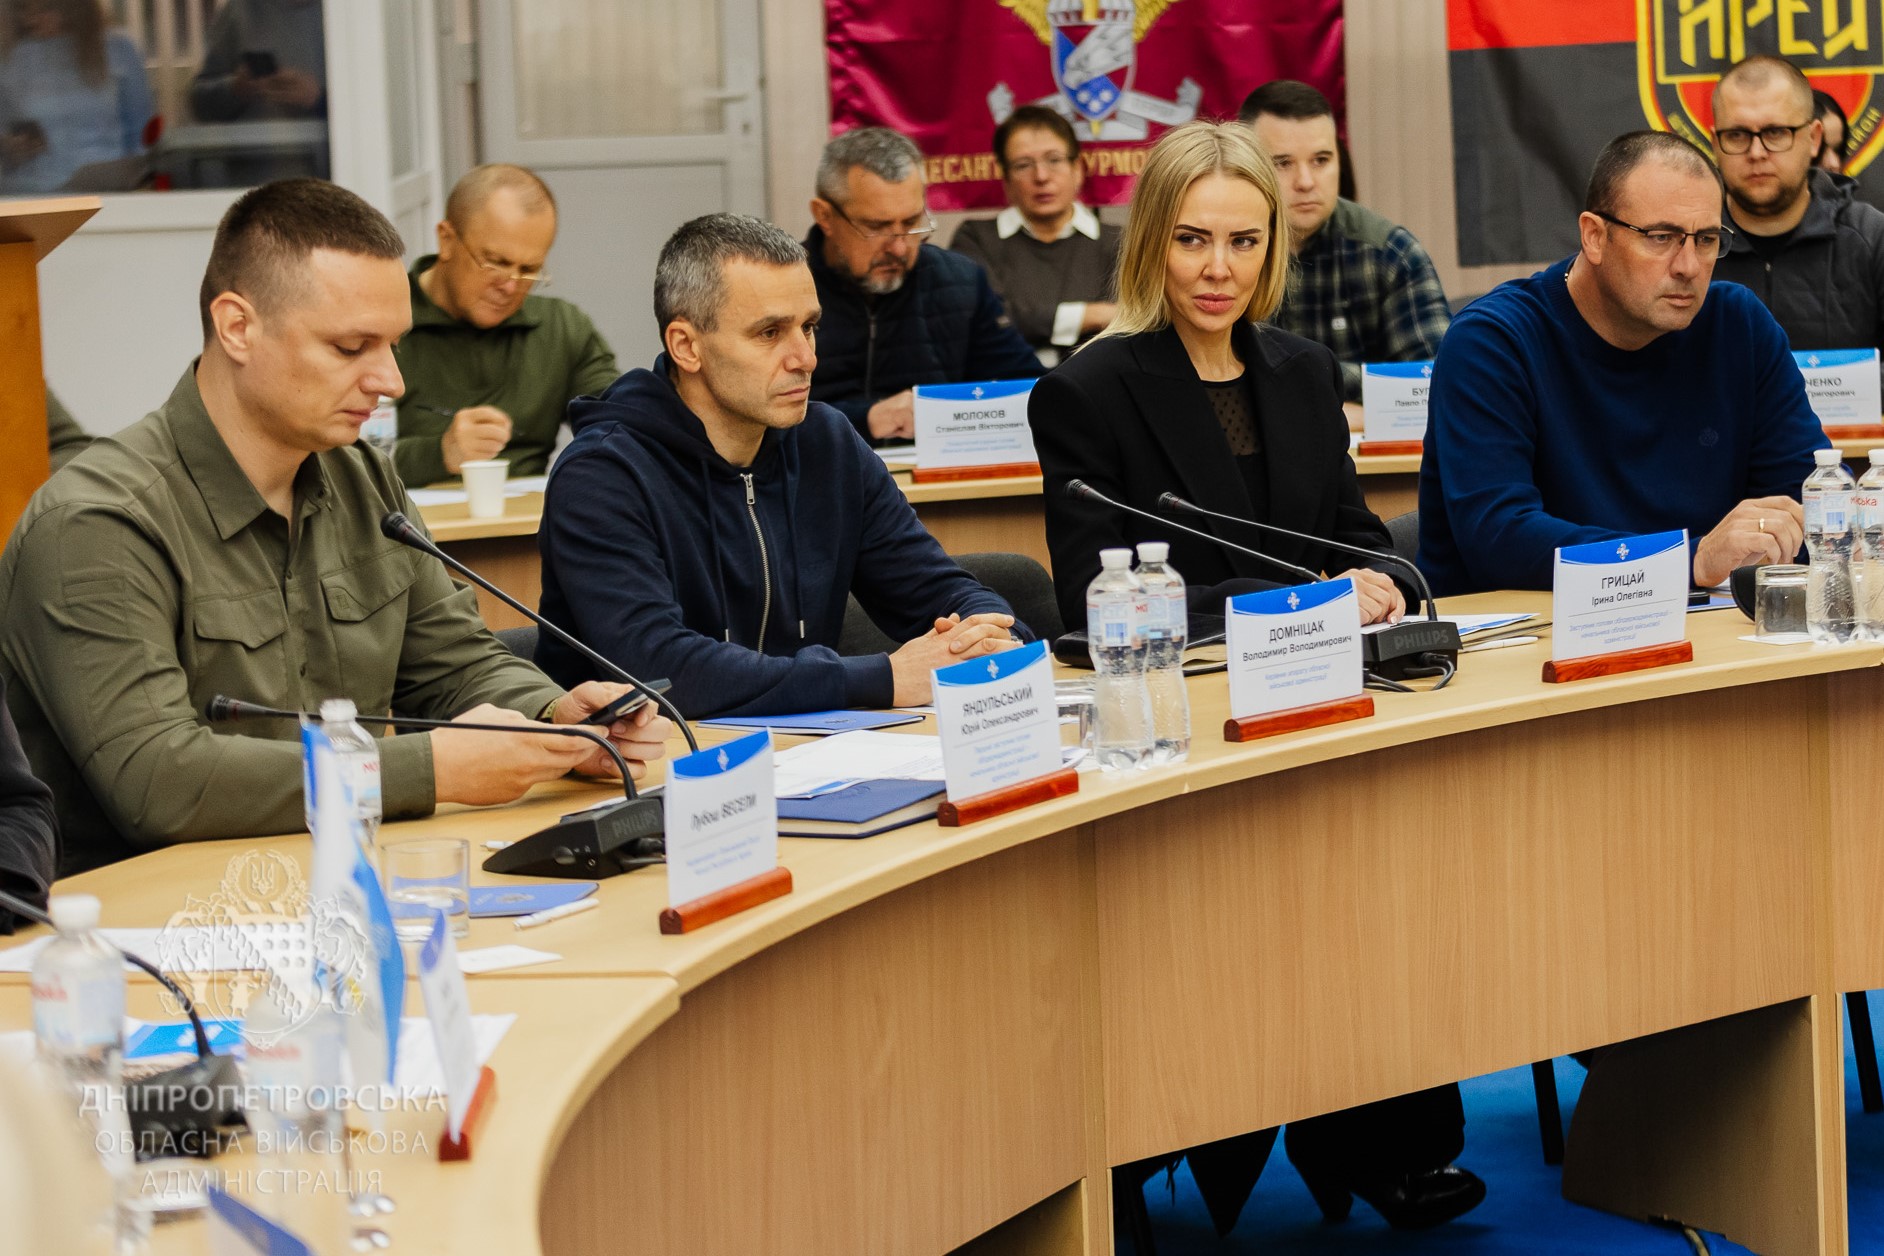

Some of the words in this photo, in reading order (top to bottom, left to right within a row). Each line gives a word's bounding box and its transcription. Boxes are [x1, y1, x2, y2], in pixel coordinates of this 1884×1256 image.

[1806, 377, 1842, 387] ЧЕНКО
[1395, 399, 1420, 407] Павло
[953, 410, 1005, 421] МОЛОКОВ
[935, 424, 976, 434] Станіслав
[979, 421, 1024, 431] Вікторович
[1601, 569, 1645, 589] ГРИЦАЙ
[1591, 595, 1614, 607] Ірина
[1616, 588, 1653, 602] Олегівна
[1268, 620, 1325, 644] ДОМНІЦАК
[1392, 629, 1449, 651] PHILIPS
[1242, 644, 1288, 662] Володимир
[1289, 635, 1352, 654] Володимирович
[963, 683, 1033, 718] ЯНДУЛЬСЬКИЙ
[961, 721, 980, 736] Юрій
[982, 707, 1039, 730] Олександрович
